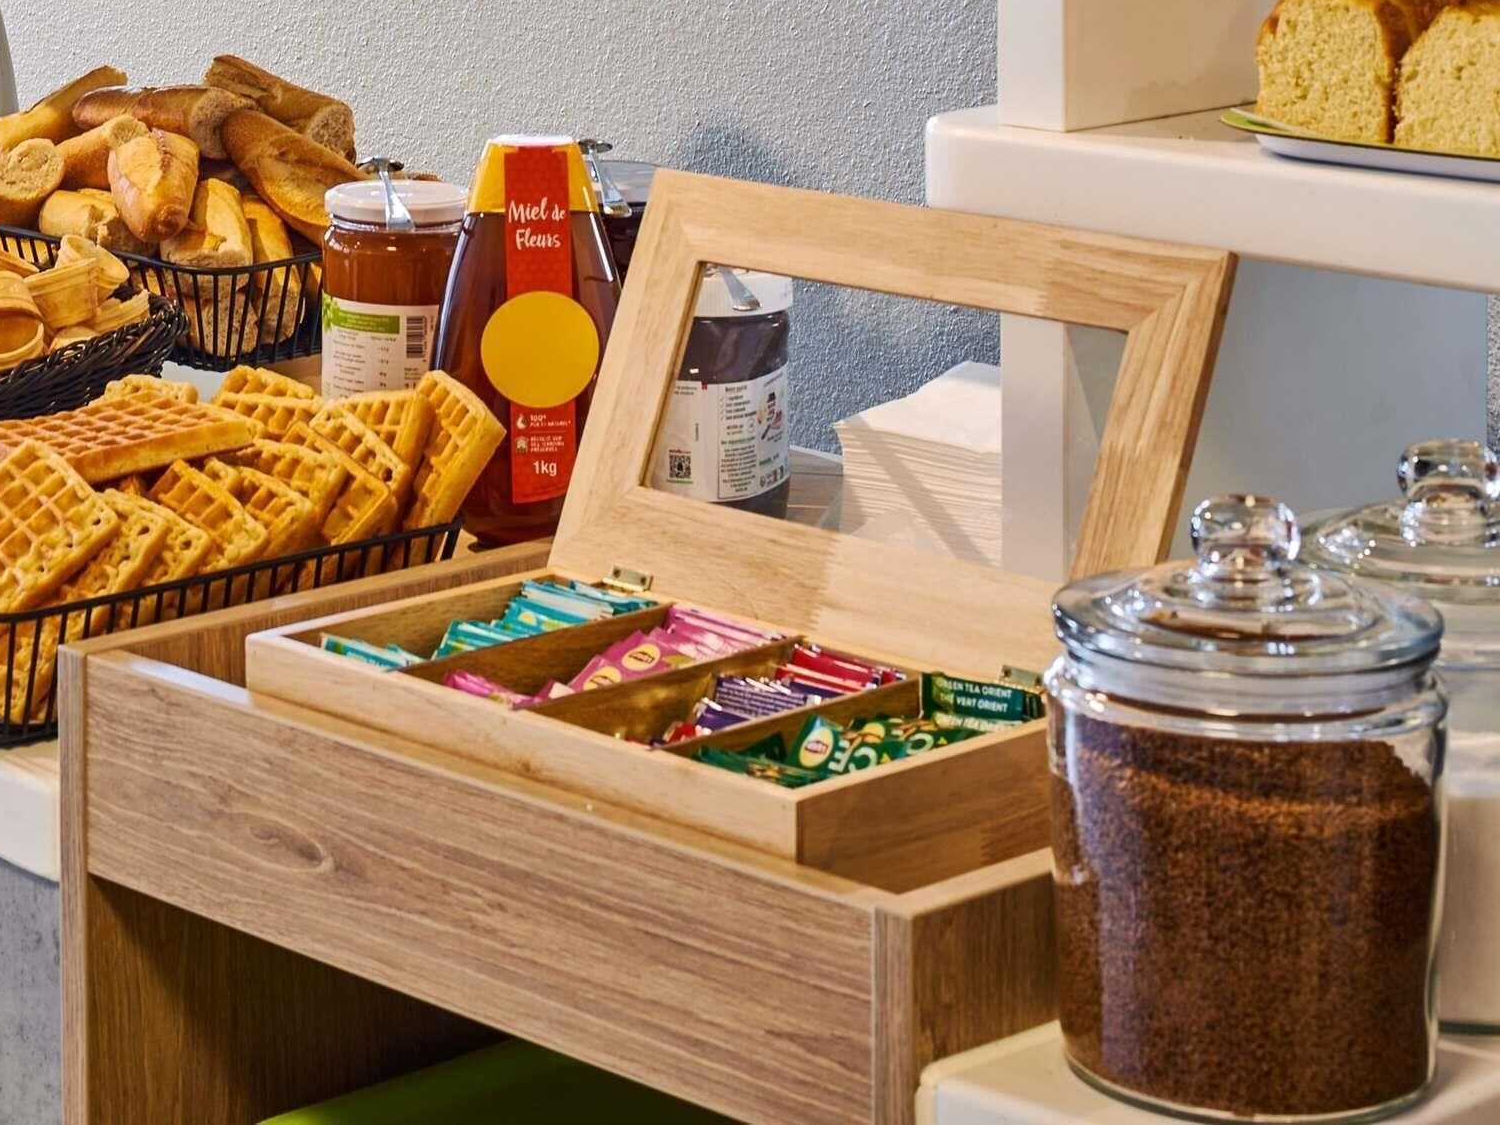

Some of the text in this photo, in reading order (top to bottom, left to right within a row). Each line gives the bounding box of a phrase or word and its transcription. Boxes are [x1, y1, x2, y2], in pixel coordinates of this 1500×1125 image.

[508, 196, 566, 224] Miel de
[515, 227, 561, 251] Fleurs
[533, 459, 557, 477] 1kg
[982, 686, 1012, 698] ORIENT
[977, 699, 1009, 712] ORIENT
